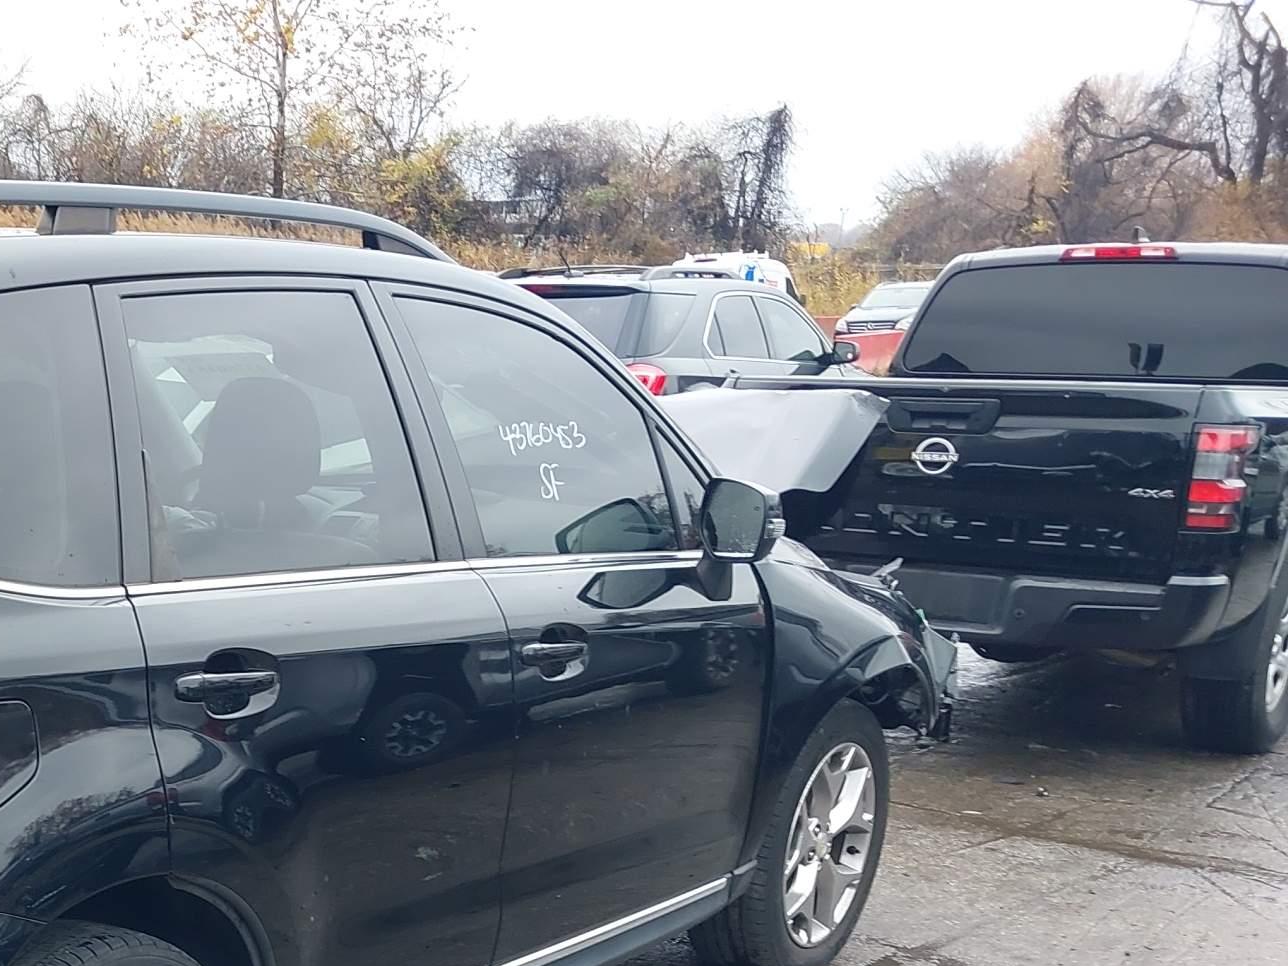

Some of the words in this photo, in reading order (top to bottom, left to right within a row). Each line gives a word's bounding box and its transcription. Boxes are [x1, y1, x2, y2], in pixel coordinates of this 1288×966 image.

[498, 420, 586, 456] 43760453
[911, 451, 960, 463] NISSAN
[539, 463, 565, 501] SF
